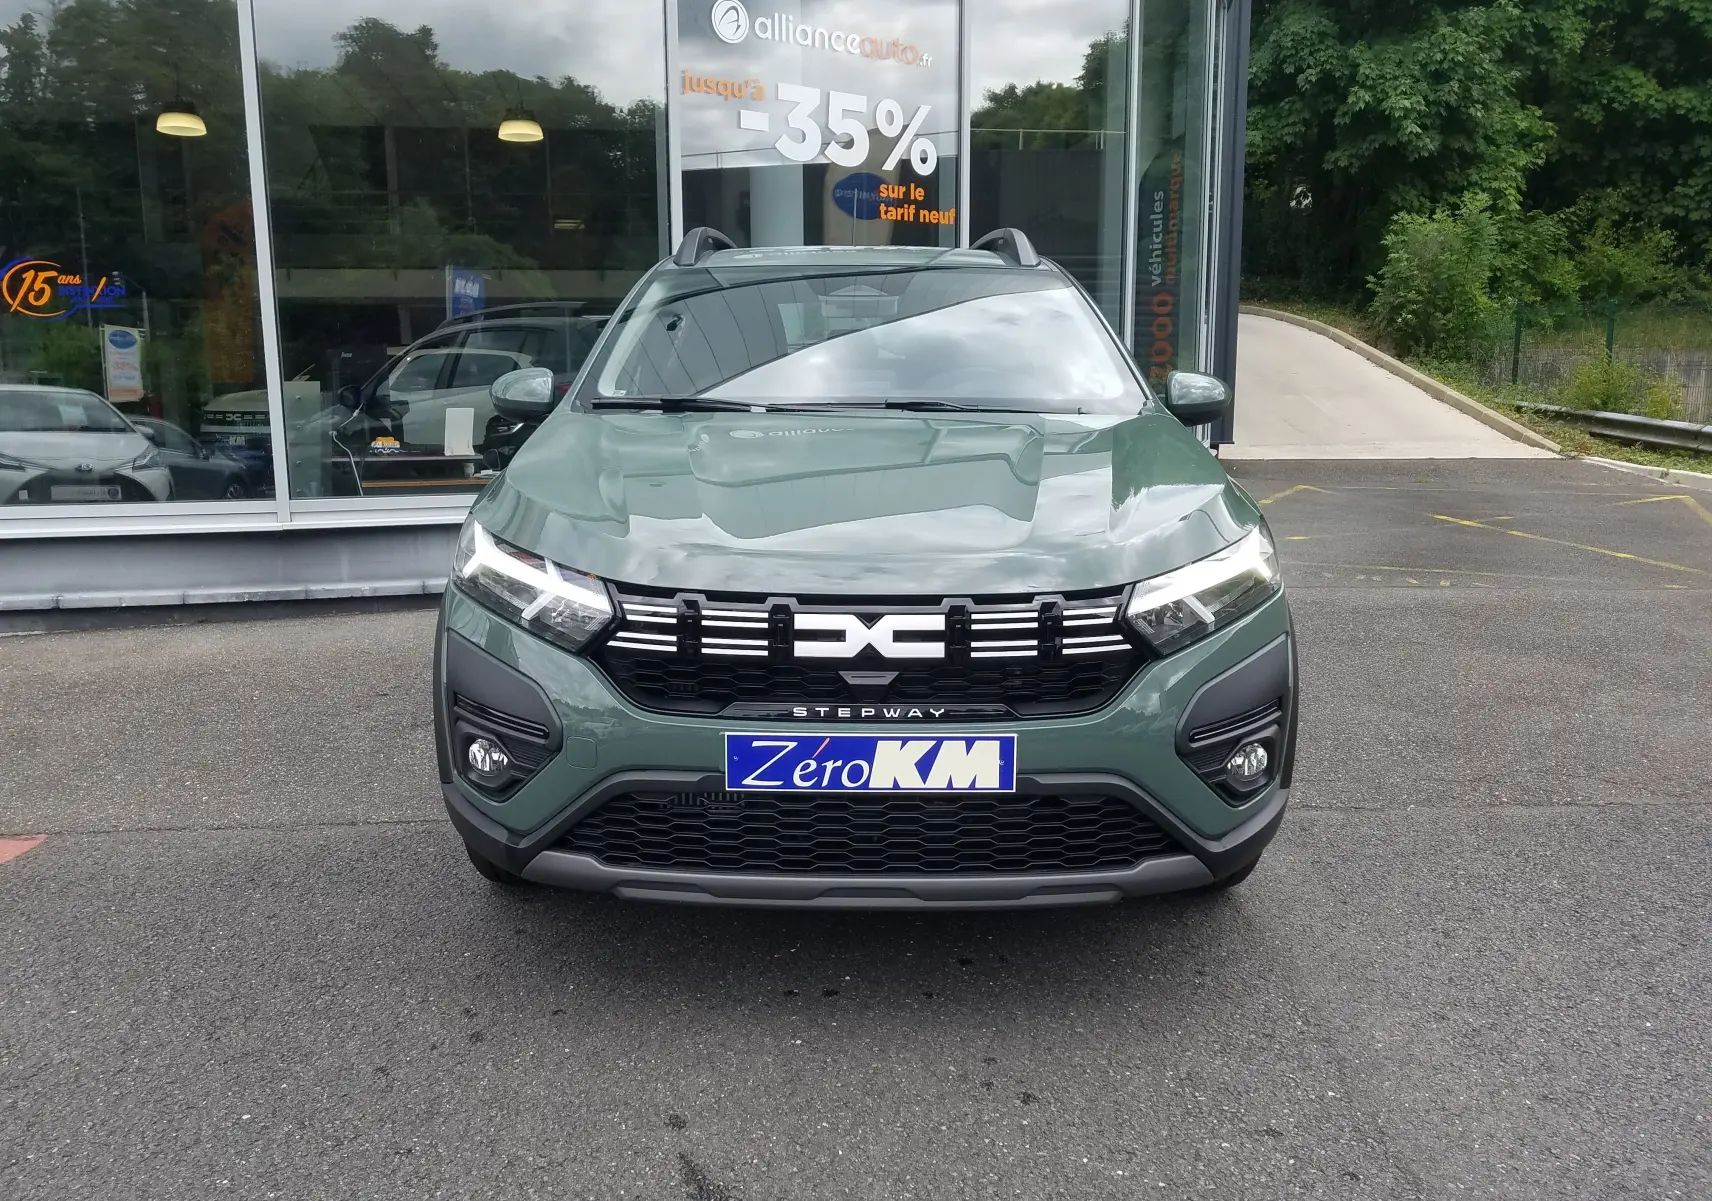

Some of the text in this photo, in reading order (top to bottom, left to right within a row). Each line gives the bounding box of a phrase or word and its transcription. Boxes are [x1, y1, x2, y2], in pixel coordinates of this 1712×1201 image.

[879, 182, 925, 201] sur le
[879, 203, 956, 224] tarif neuf
[1149, 190, 1164, 287] véhicules
[10, 269, 82, 312] 15 ans
[792, 707, 945, 718] STEPWAY
